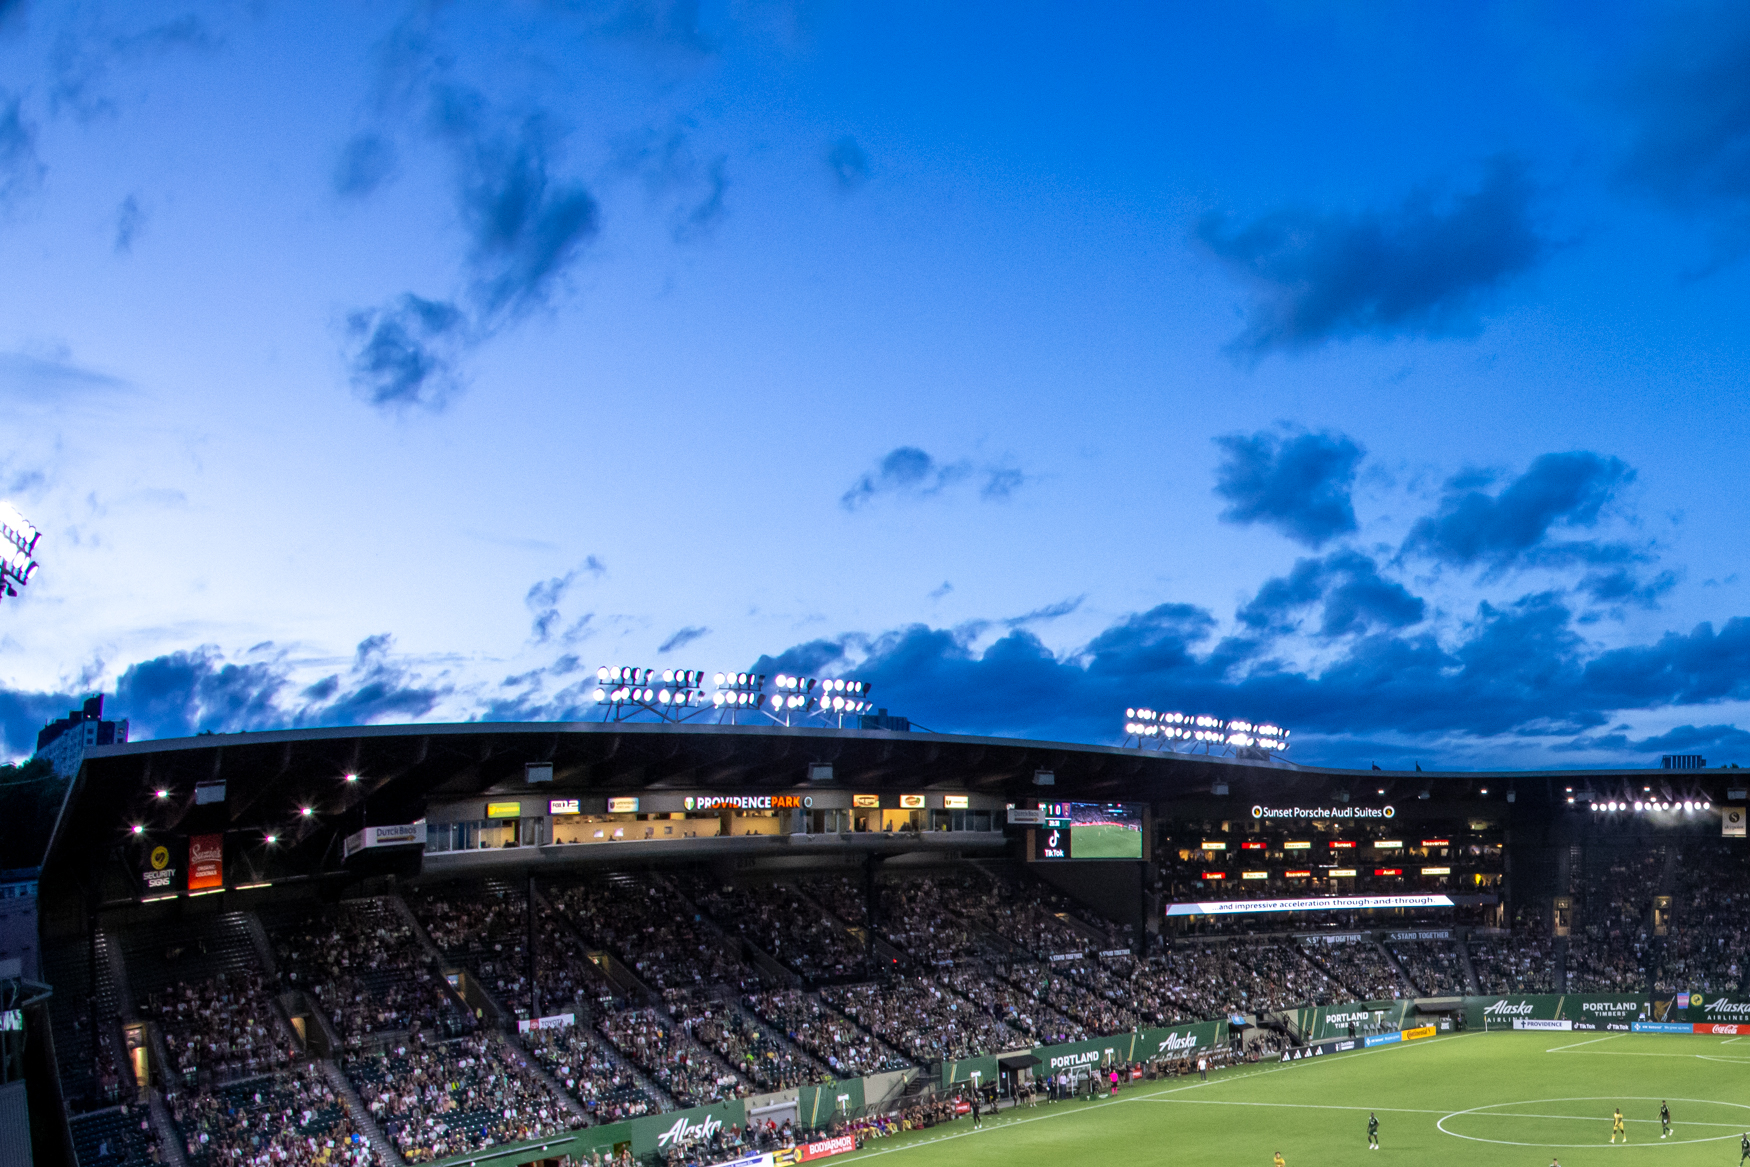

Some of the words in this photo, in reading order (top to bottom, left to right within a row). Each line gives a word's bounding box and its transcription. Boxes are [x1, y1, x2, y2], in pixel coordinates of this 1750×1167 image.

[697, 796, 771, 809] PROVIDENCE
[771, 796, 800, 808] PARK
[1263, 807, 1293, 818] Sunset
[1294, 807, 1330, 819] Porsche
[1331, 807, 1353, 818] Audi
[1354, 807, 1382, 818] Suites
[1044, 849, 1064, 858] TikTok
[143, 869, 176, 880] SECURITY
[149, 878, 170, 888] SIGNS
[1234, 901, 1278, 911] impressive
[1279, 900, 1329, 909] acceleration
[1332, 898, 1436, 907] through-and-through.
[1397, 933, 1417, 941] STAND
[1418, 931, 1449, 940] TOGETHER
[1483, 1000, 1534, 1015] Alaska
[1583, 1002, 1637, 1011] PORTLAND
[1326, 1012, 1369, 1024] PORTLAND
[1712, 1024, 1739, 1035] Coca-Cola
[1159, 1031, 1197, 1051] Alaska
[1051, 1051, 1099, 1069] PORTLAND
[658, 1114, 722, 1147] Alaska
[809, 1136, 852, 1155] BODYARMOR
